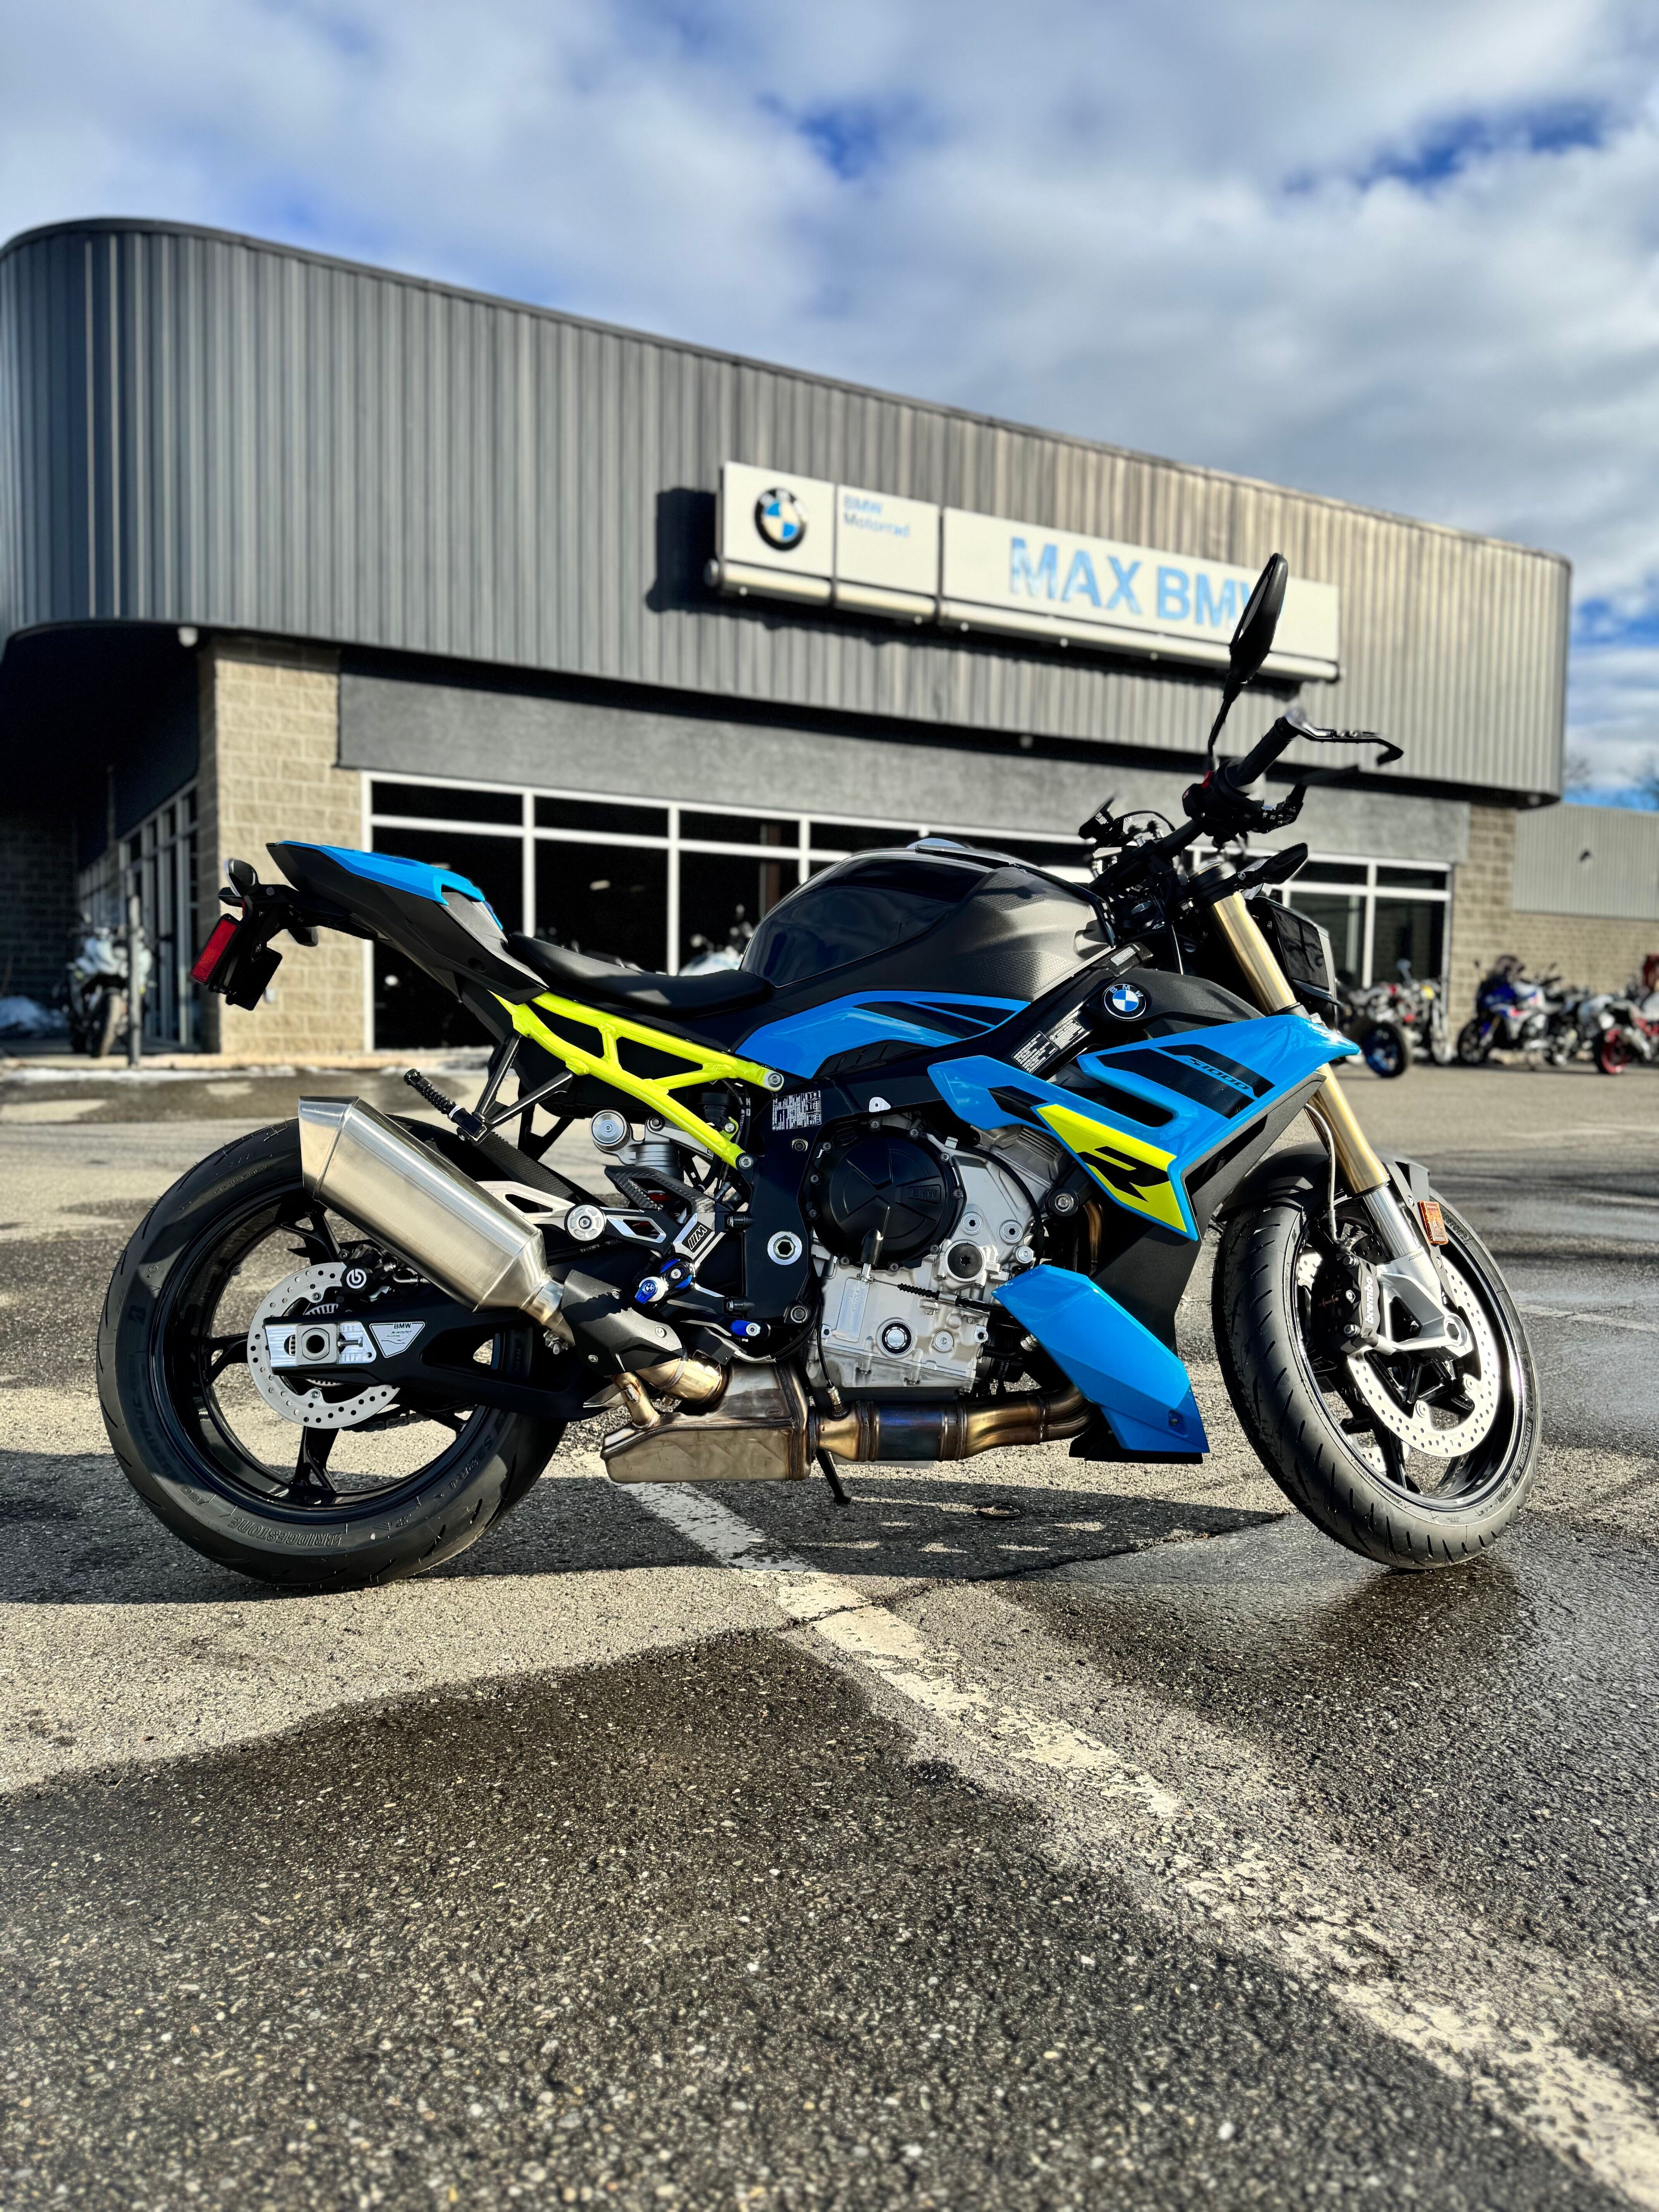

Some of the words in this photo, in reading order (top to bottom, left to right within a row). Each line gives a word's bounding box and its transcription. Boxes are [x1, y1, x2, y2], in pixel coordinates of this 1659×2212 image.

[844, 494, 883, 515] BMW
[843, 513, 910, 538] Motorrad
[1011, 537, 1143, 615] MAX
[1109, 984, 1144, 998] BMW
[1184, 1058, 1250, 1090] S1000
[913, 1189, 937, 1198] BMW
[1364, 1276, 1374, 1324] brembo
[1519, 1421, 1532, 1469] HYPERSPORT
[228, 1516, 342, 1547] BRIDGESTONE
